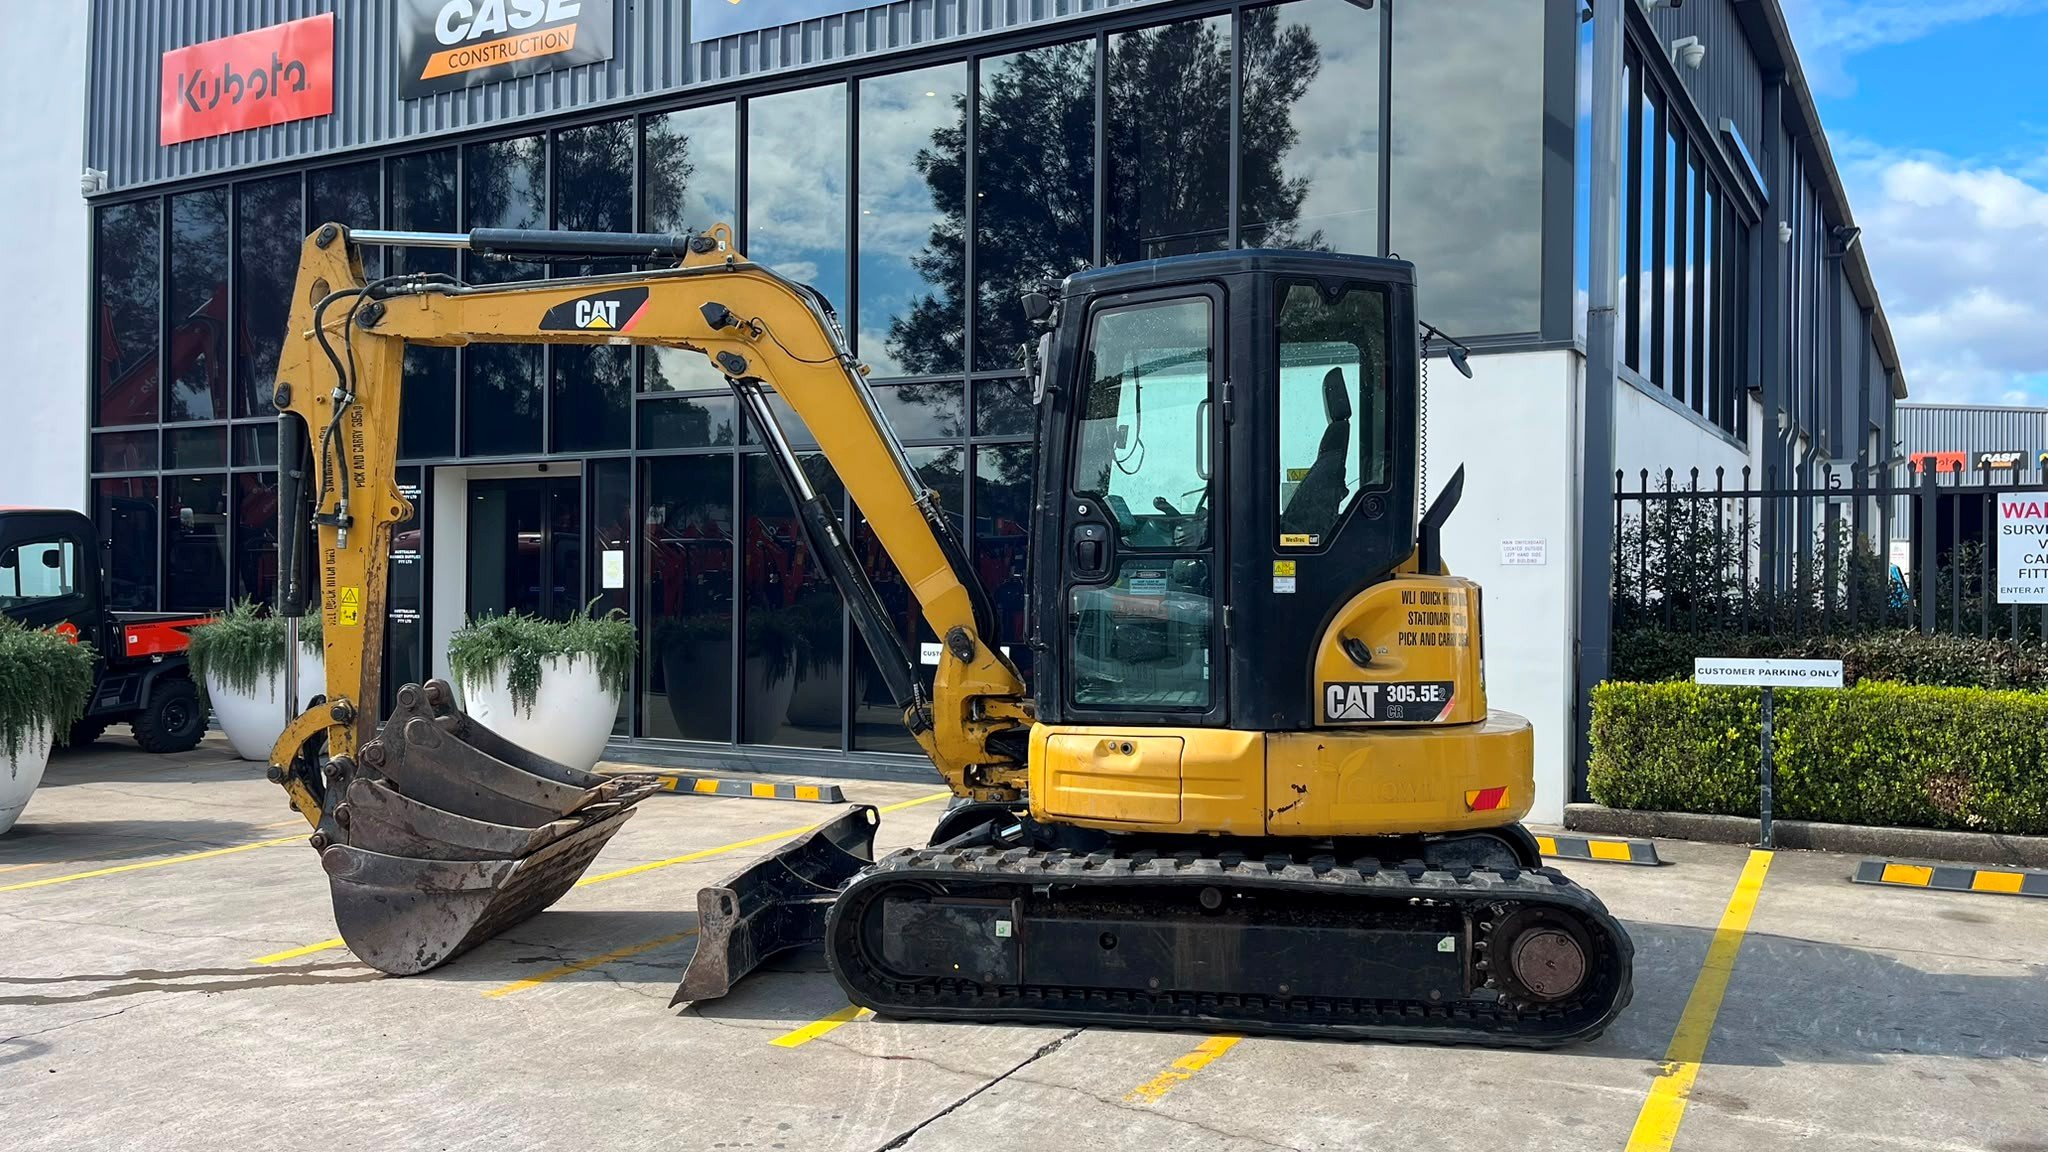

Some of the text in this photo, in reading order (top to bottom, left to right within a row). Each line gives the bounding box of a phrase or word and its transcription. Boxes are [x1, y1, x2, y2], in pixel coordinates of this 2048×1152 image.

[435, 0, 582, 46] CASE
[448, 29, 570, 69] CONSTRUCTION
[178, 51, 306, 113] Kubota
[575, 300, 620, 328] CAT
[352, 430, 364, 453] CARRY
[352, 454, 365, 470] AND
[2002, 502, 2048, 519] WA
[2003, 524, 2048, 535] SURV
[2024, 553, 2048, 564] CA
[1401, 590, 1416, 605] WLI
[1420, 590, 1441, 605] QUICK
[2001, 586, 2045, 594] ENTER AT
[1408, 611, 1451, 626] STATIONARY
[1398, 631, 1418, 647] PICK
[1419, 632, 1436, 647] AND
[1438, 632, 1457, 647] CARRY
[1697, 667, 1755, 676] CUSTOMER
[1758, 668, 1807, 677] PARKING
[1326, 684, 1446, 719] CAT 305.5E2
[1386, 705, 1404, 718] CR
